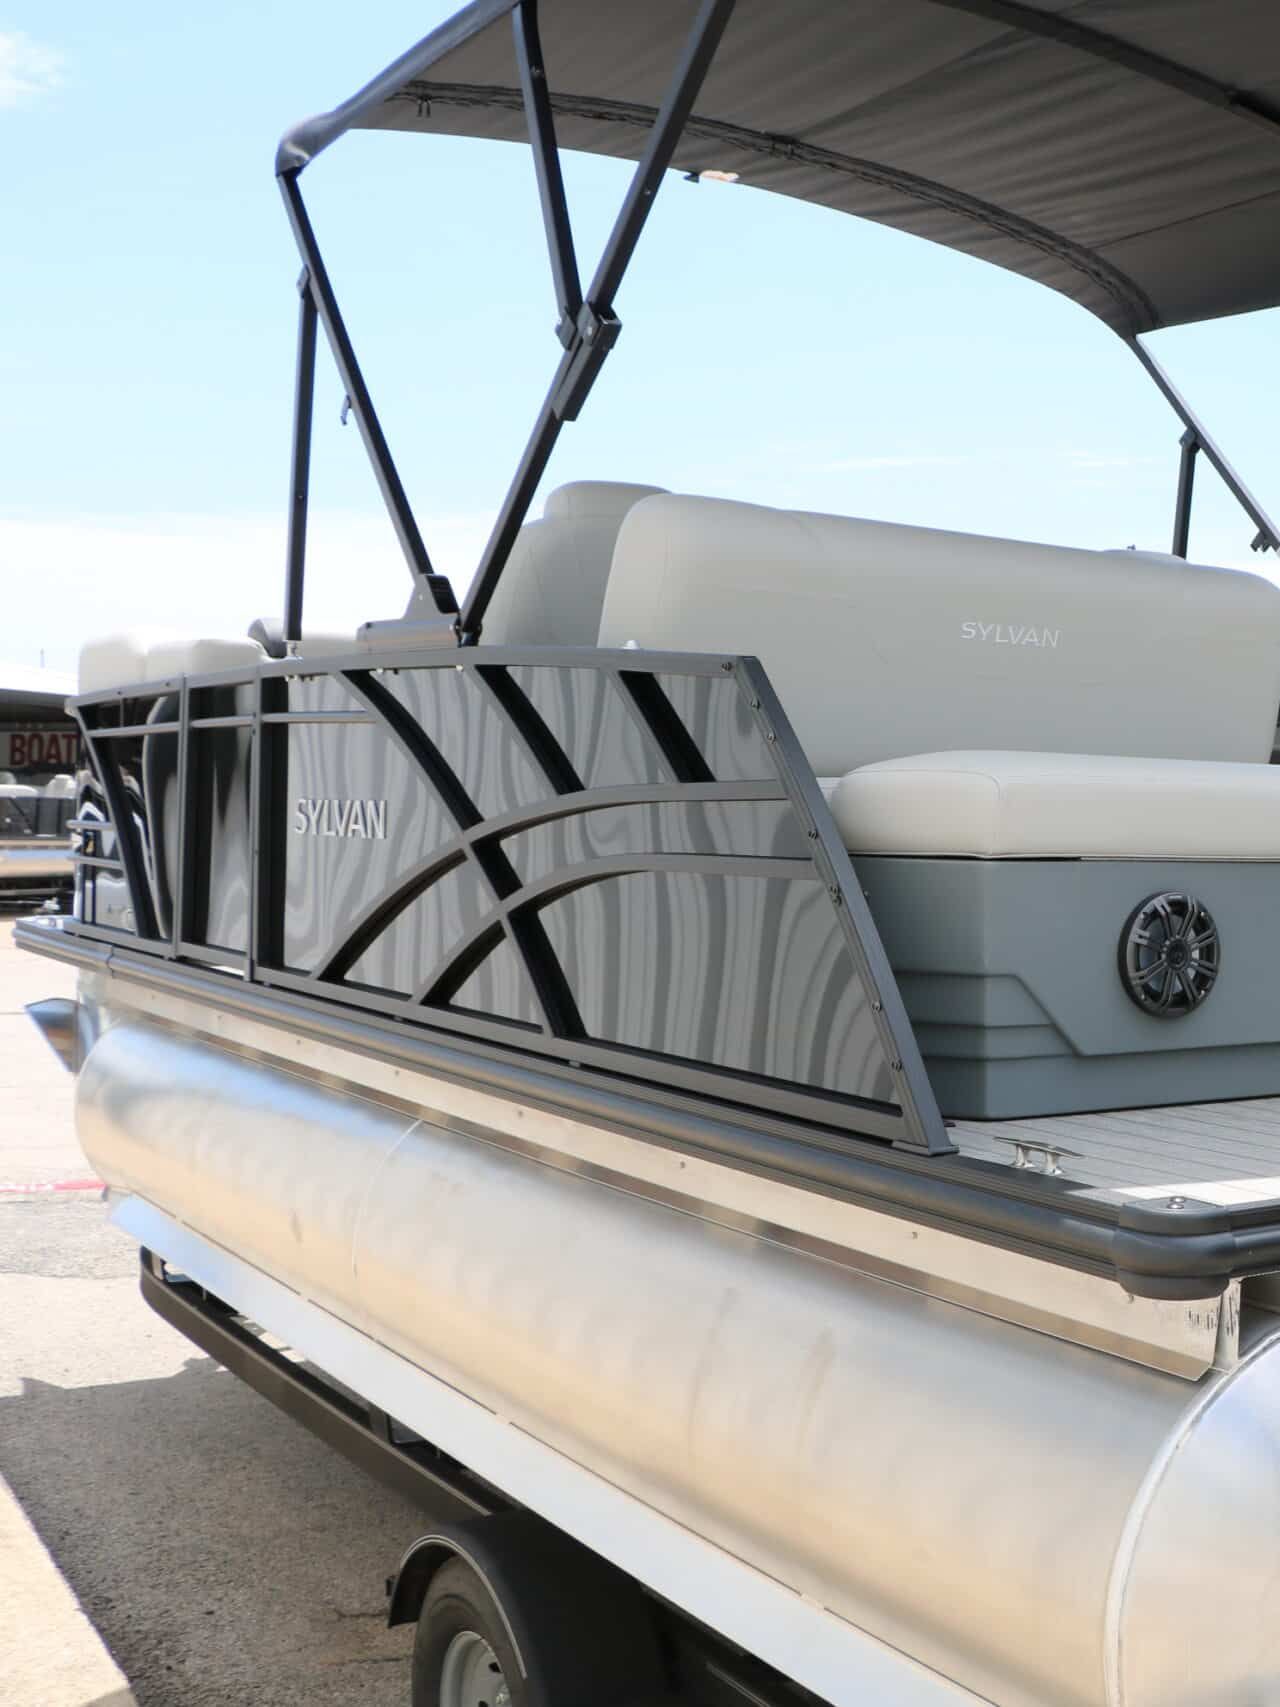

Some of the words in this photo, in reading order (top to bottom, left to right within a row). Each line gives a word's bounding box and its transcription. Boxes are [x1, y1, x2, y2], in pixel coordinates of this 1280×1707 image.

[960, 621, 1061, 648] SYLVAN
[10, 733, 80, 766] BOAT
[295, 798, 388, 840] SYLVAN
